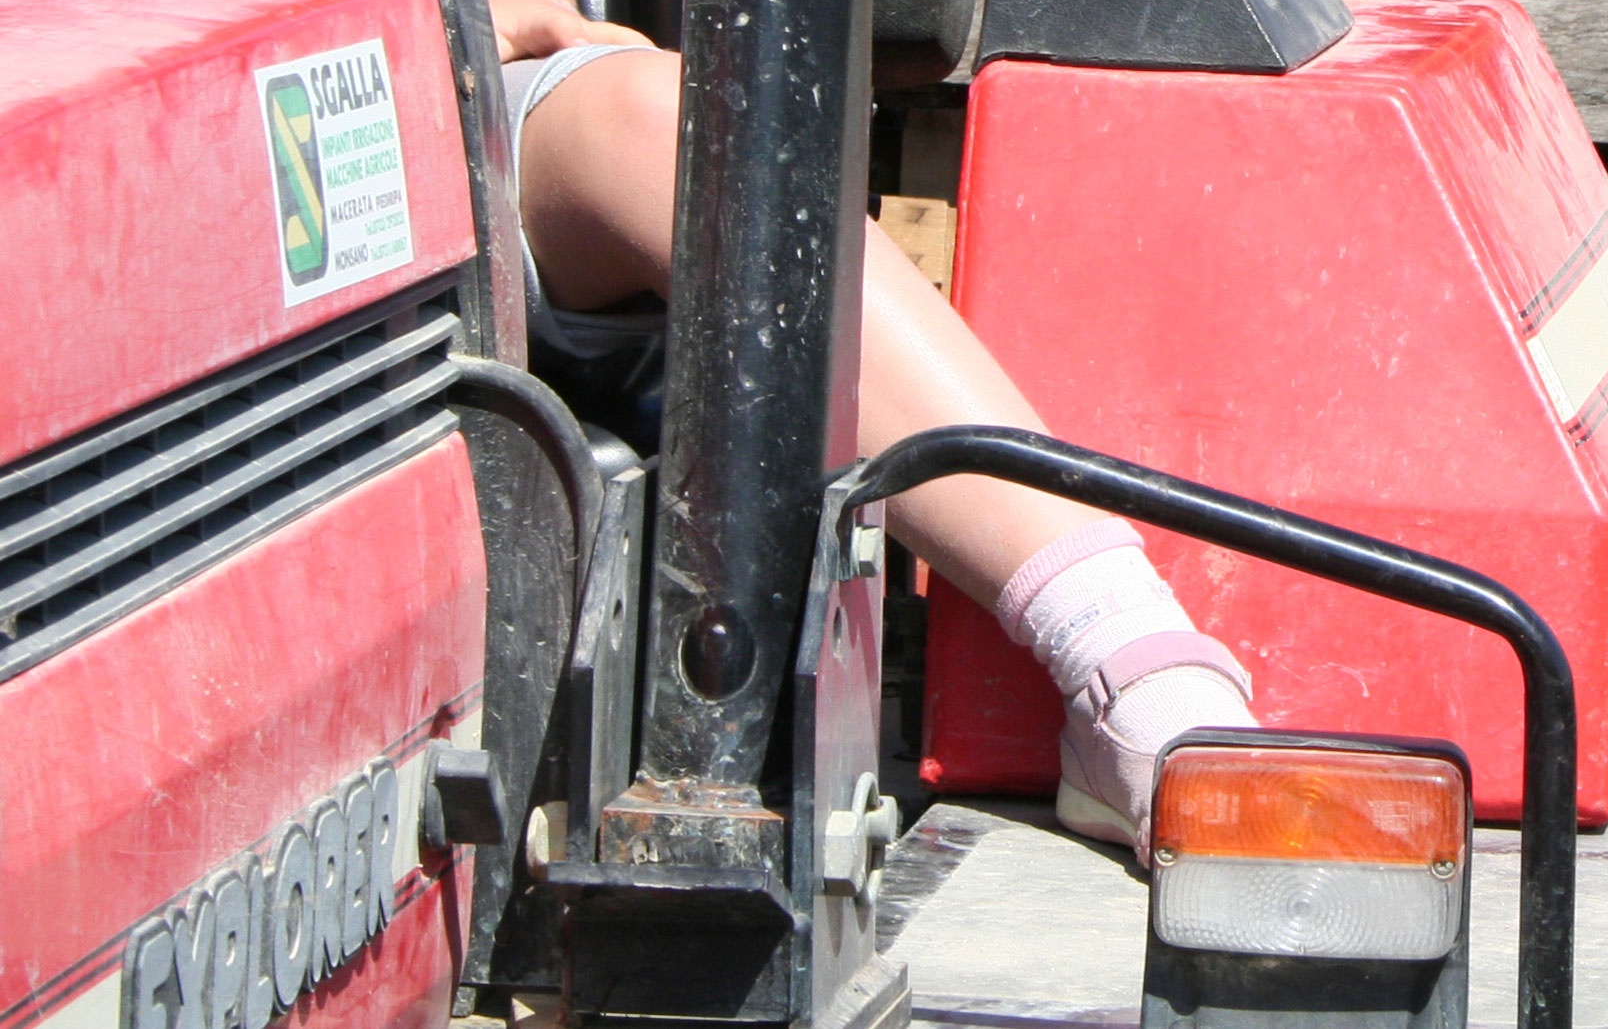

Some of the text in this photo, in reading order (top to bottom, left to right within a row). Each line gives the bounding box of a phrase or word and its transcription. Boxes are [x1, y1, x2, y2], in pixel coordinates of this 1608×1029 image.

[310, 53, 388, 120] SGALLA
[364, 147, 398, 182] AGRICOLE
[330, 195, 373, 225] MACERATA
